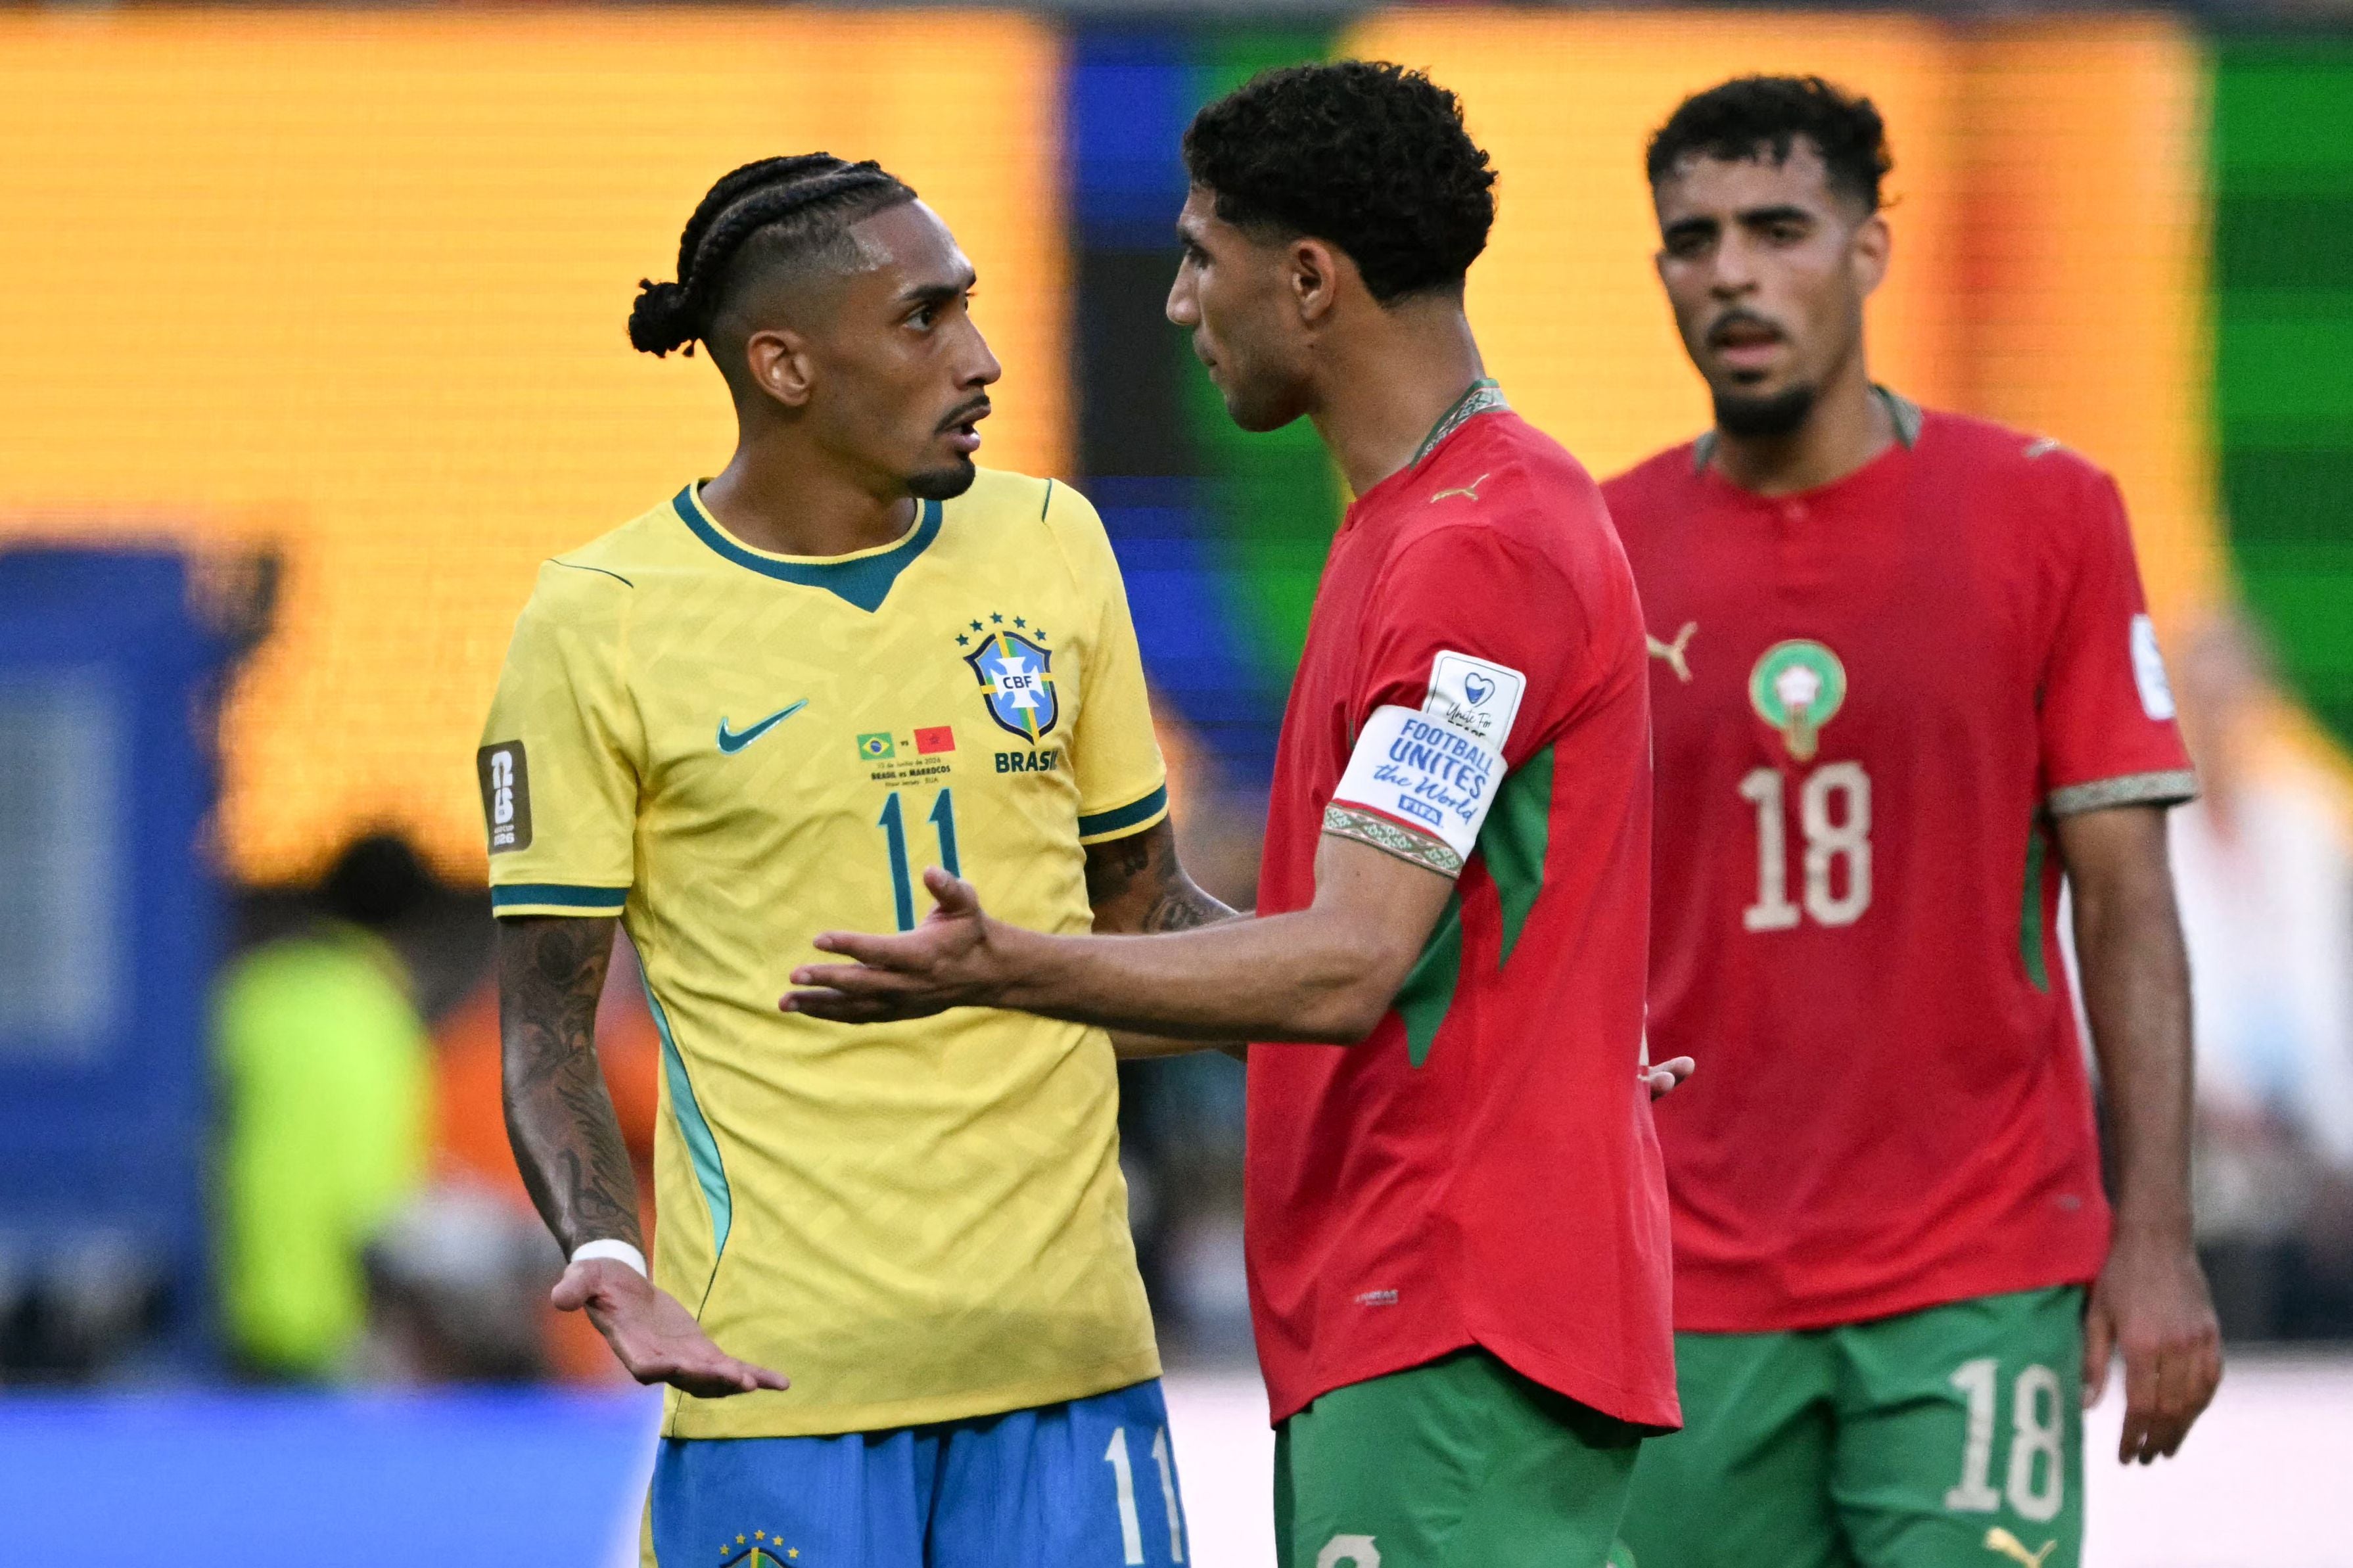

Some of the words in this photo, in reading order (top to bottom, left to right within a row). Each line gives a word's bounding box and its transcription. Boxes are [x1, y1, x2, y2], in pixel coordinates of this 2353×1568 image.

[1003, 676, 1033, 689] CBF
[1446, 702, 1475, 724] Unite
[1479, 712, 1492, 728] For
[909, 766, 951, 776] MARROCOS
[1389, 737, 1486, 799] UNITES
[1401, 718, 1493, 776] FOOTBALL
[1374, 764, 1412, 786] the
[1414, 776, 1478, 825] World
[1400, 795, 1441, 825] FIFA
[877, 787, 961, 933] 11
[1739, 760, 1873, 933] 18
[1944, 1358, 2064, 1522] 18
[1104, 1425, 1183, 1565] 11
